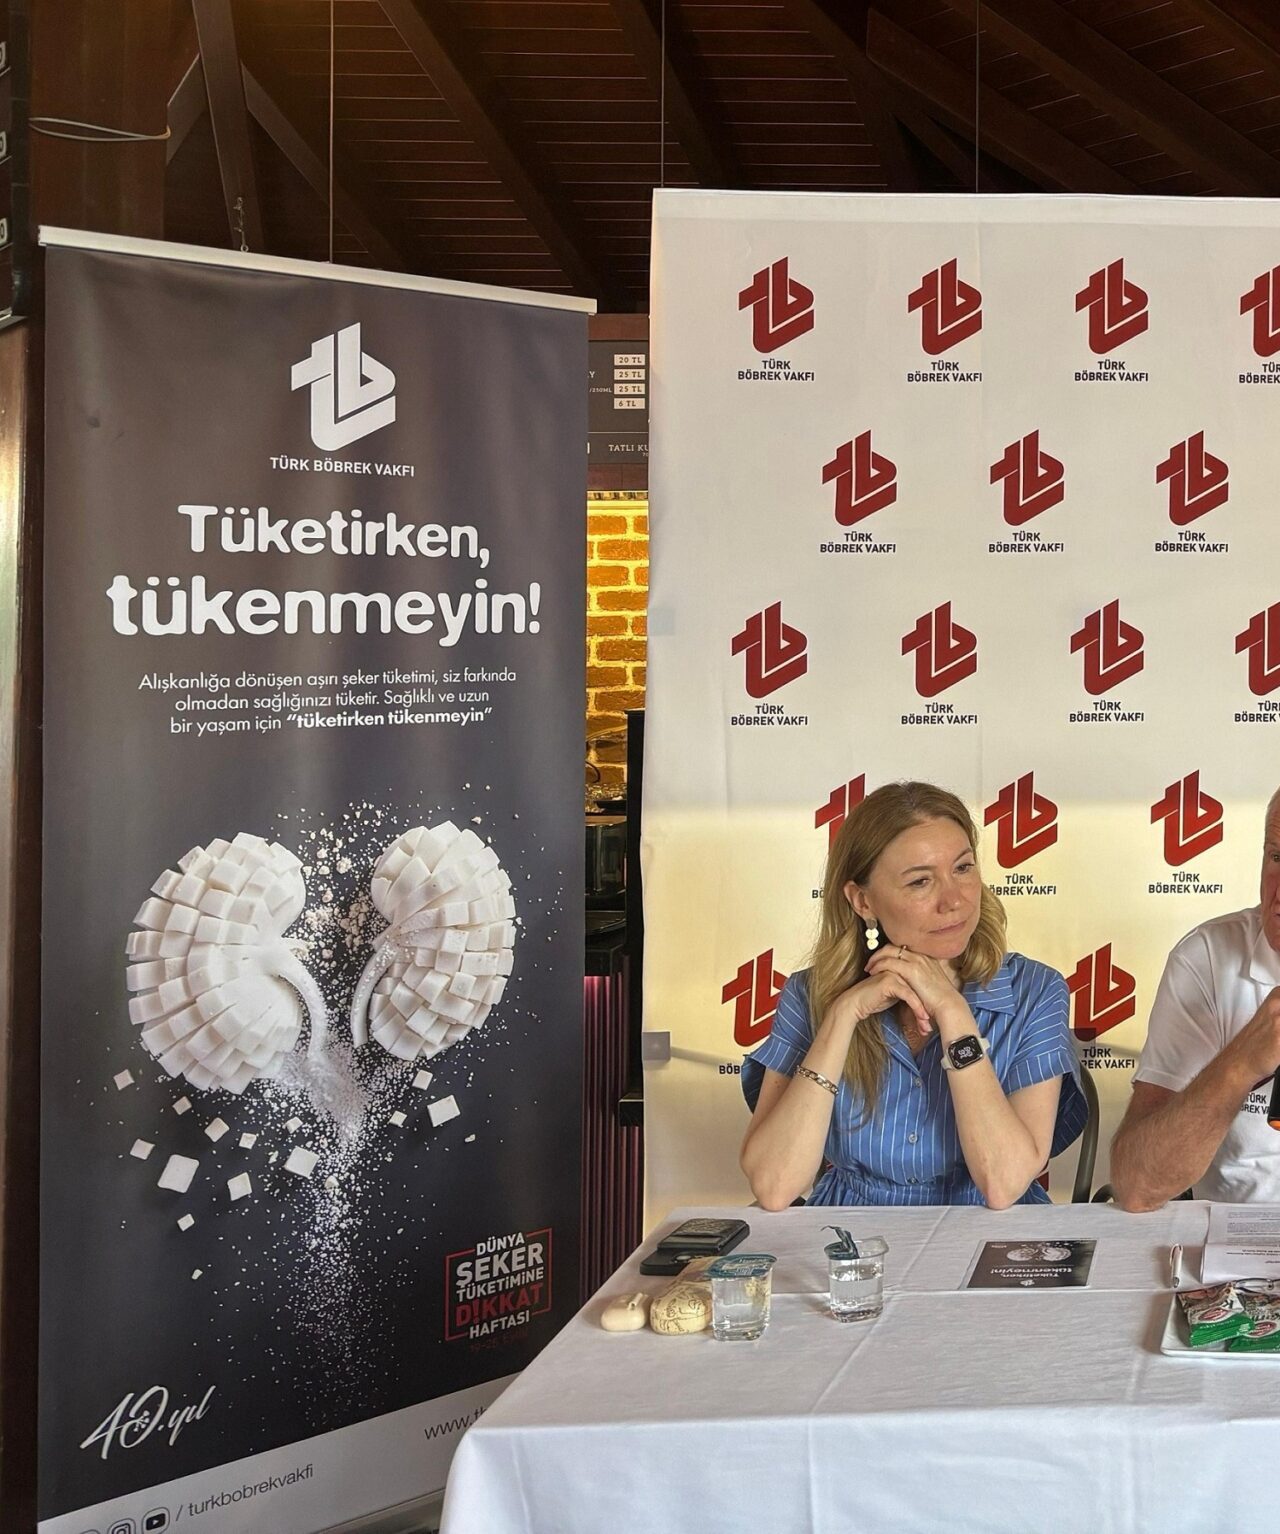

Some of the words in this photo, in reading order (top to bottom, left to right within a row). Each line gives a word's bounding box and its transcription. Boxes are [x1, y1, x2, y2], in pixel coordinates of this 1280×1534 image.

[762, 358, 790, 369] TÜRK
[931, 360, 959, 371] TÜRK
[1098, 359, 1125, 370] TÜRK
[738, 368, 782, 381] BÖBREK
[784, 371, 815, 381] VAKFI
[908, 370, 951, 382] BÖBREK
[952, 372, 983, 382] VAKFI
[1075, 369, 1117, 381] BÖBREK
[1119, 371, 1149, 381] VAKFI
[1239, 372, 1280, 384] BÖBREK
[618, 385, 629, 393] 25
[631, 385, 642, 393] TL
[608, 444, 635, 452] TATLI
[270, 455, 310, 471] TÜRK
[313, 457, 372, 475] BÖBREK
[374, 463, 415, 478] VAKFI
[177, 504, 491, 569] Tüketirken,
[844, 531, 872, 542] TÜRK
[1012, 531, 1040, 542] TÜRK
[1178, 530, 1205, 541] TÜRK
[820, 541, 864, 553] BÖBREK
[865, 543, 897, 553] VAKFI
[989, 541, 1032, 552] BÖBREK
[1034, 542, 1065, 552] VAKFI
[1155, 540, 1197, 552] BÖBREK
[1199, 542, 1229, 552] VAKFI
[106, 574, 542, 647] tükenmeyin!
[138, 671, 231, 693] Alışkanlığa
[235, 671, 302, 690] dönüşen
[307, 674, 338, 690] aşırı
[342, 669, 379, 688] şeker
[383, 668, 439, 686] tüketimi,
[443, 669, 460, 683] siz
[464, 666, 516, 682] farkında
[175, 693, 249, 711] olmadan
[253, 691, 332, 712] sağlığınızı
[336, 690, 380, 706] tüketir.
[384, 688, 435, 708] Sağlıklı
[438, 692, 455, 703] ve
[458, 692, 489, 702] uzun
[1093, 700, 1121, 711] TÜRK
[755, 703, 784, 714] TÜRK
[925, 702, 953, 713] TÜRK
[731, 713, 775, 725] BÖBREK
[777, 715, 808, 725] VAKFI
[901, 712, 945, 724] BÖBREK
[947, 714, 978, 724] VAKFI
[1070, 710, 1112, 722] BÖBREK
[1114, 712, 1145, 722] VAKFI
[1235, 711, 1277, 722] BÖBREK
[170, 717, 193, 734] bir
[196, 720, 250, 737] yaşam
[255, 716, 282, 734] için
[1005, 873, 1033, 884] TÜRK
[1172, 871, 1200, 882] TÜRK
[1026, 886, 1057, 896] VAKFI
[1149, 881, 1191, 893] BÖBREK
[1193, 883, 1223, 893] VAKFI
[1083, 1047, 1111, 1058] TÜRK
[719, 1063, 741, 1075] BÖB
[1104, 1059, 1135, 1069] VAKFI
[476, 1232, 525, 1256] DÜNYA
[456, 1242, 544, 1288] ŞEKER
[469, 1310, 530, 1339] HAFTASI
[188, 1464, 314, 1518] turkbobrekvakfi
